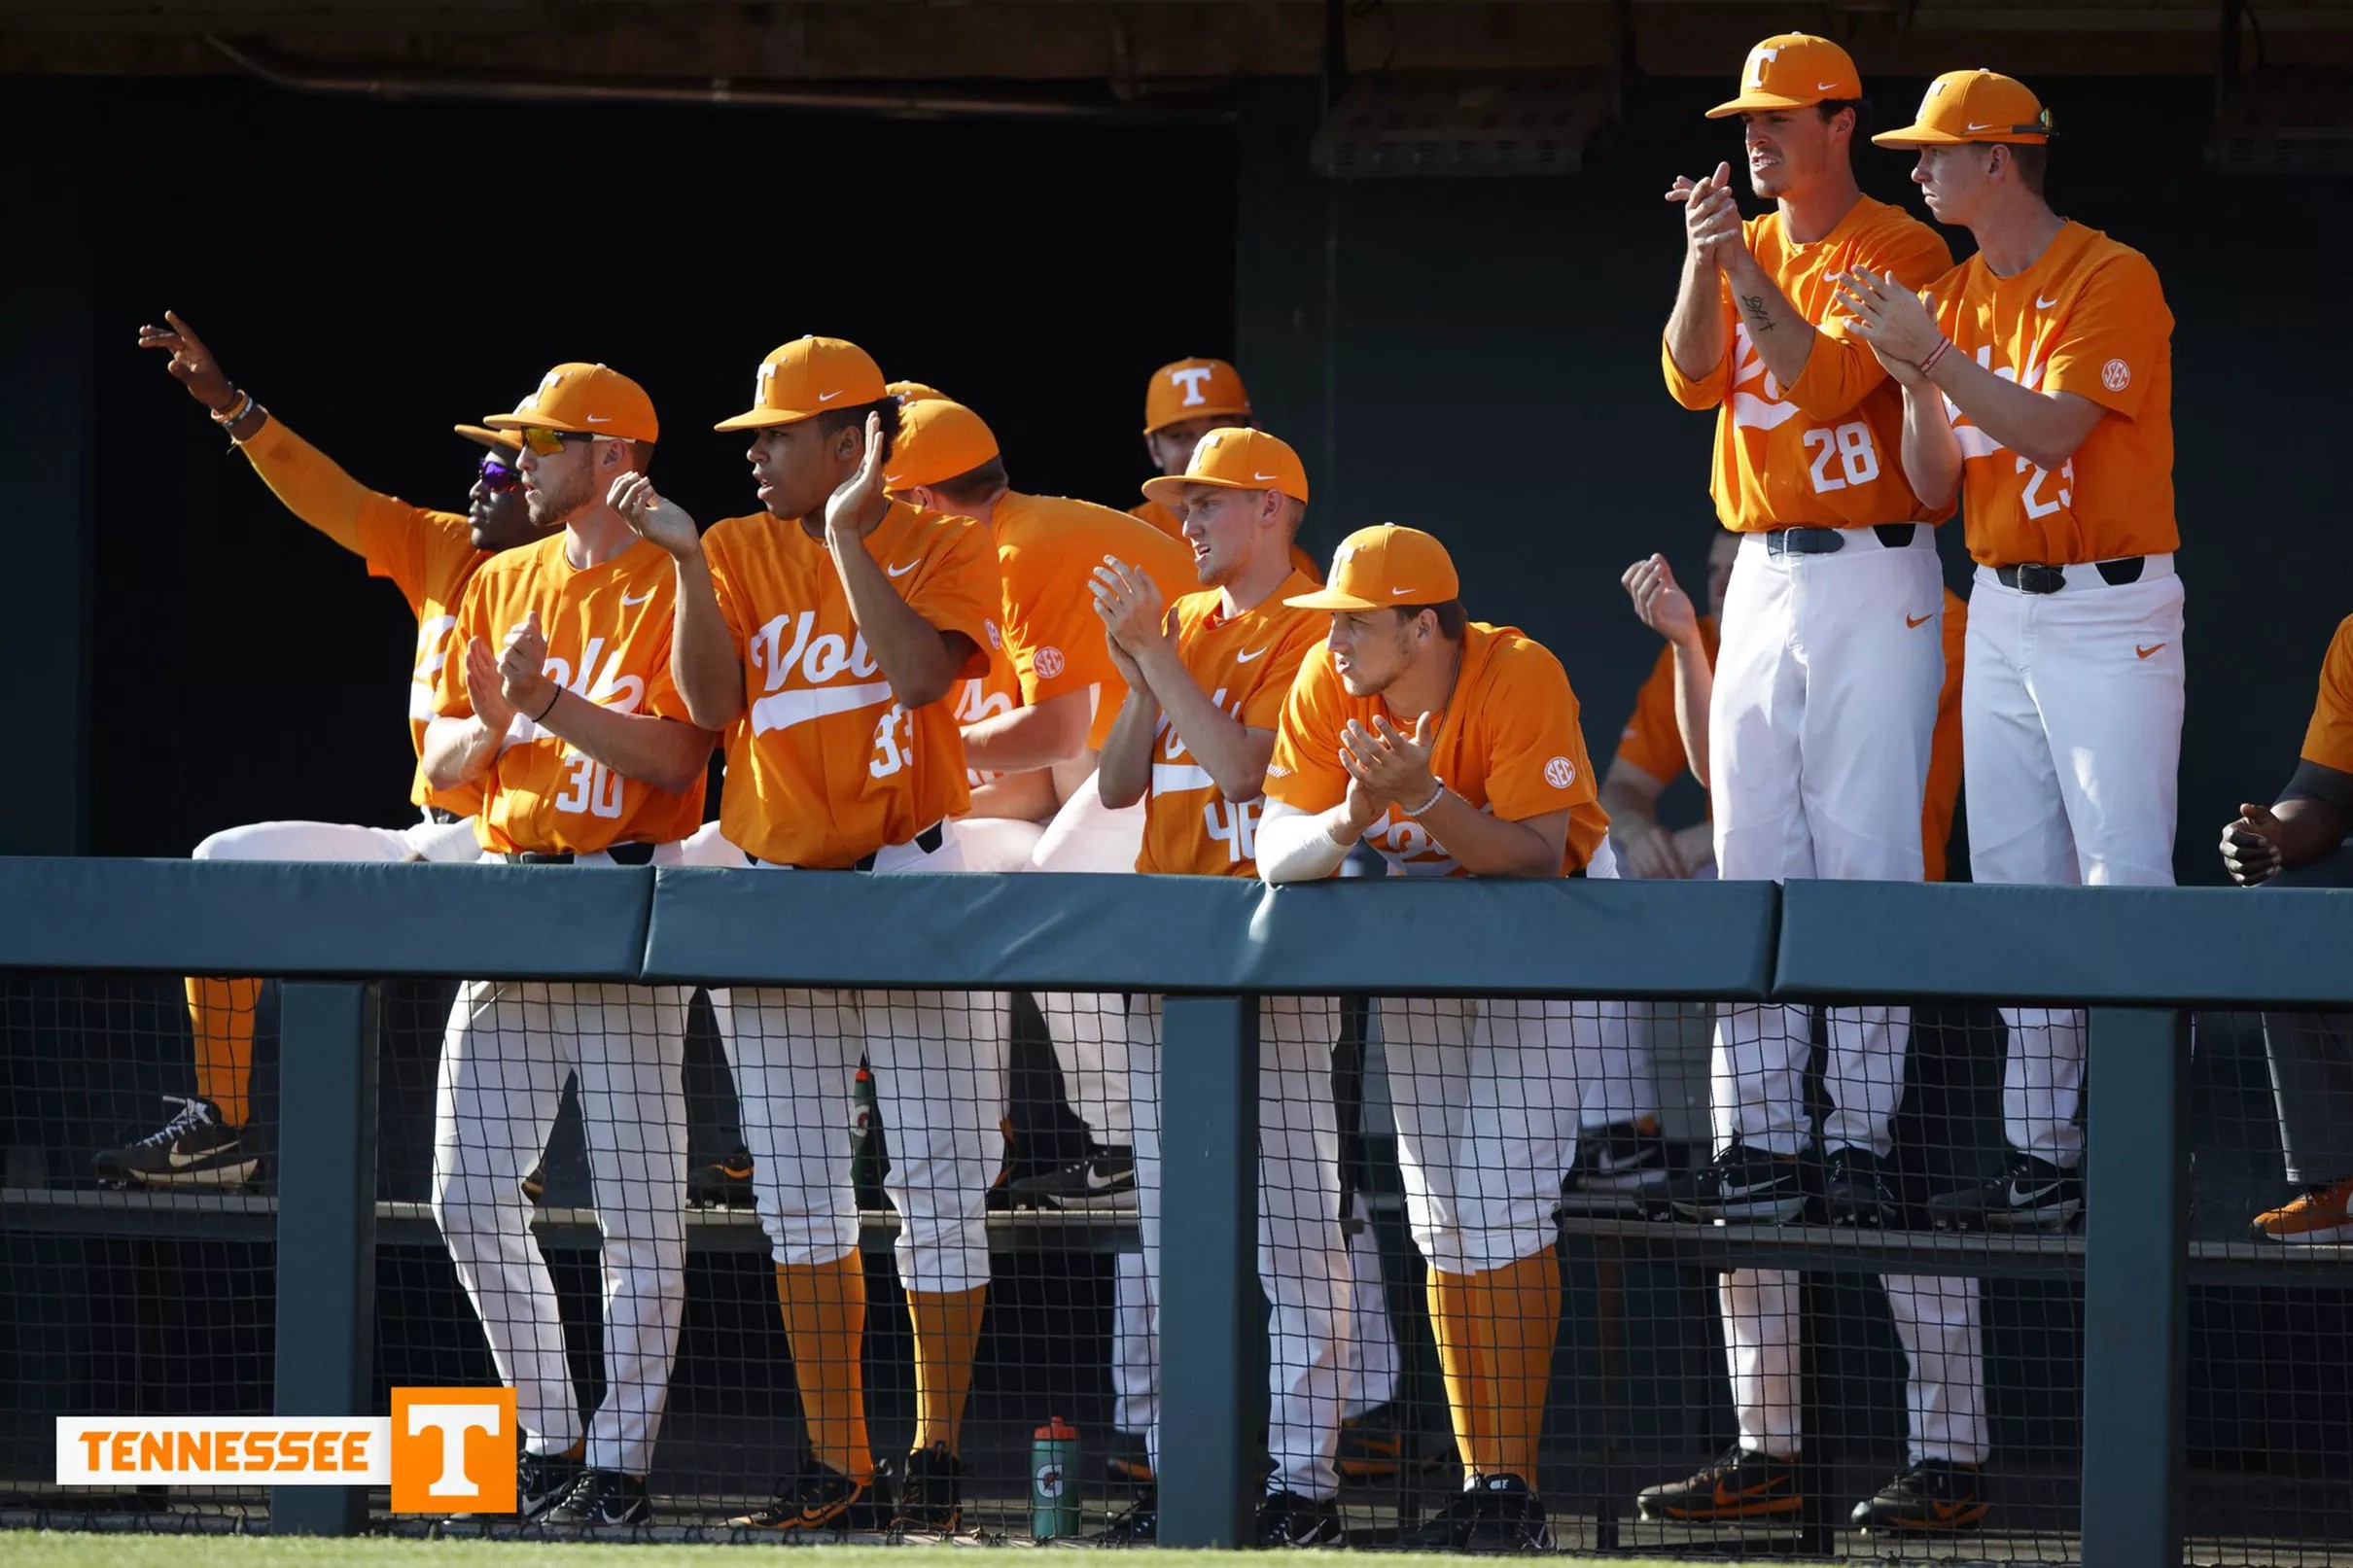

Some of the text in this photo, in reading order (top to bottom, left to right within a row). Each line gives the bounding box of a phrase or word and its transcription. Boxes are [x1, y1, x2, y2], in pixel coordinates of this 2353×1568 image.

[1172, 366, 1212, 407] T
[2104, 362, 2128, 389] SEC
[1803, 420, 1880, 494] 28
[750, 610, 879, 692] Vol
[1034, 649, 1063, 678] SEC
[555, 749, 625, 819] 30
[1547, 758, 1574, 787] SEC
[1036, 1464, 1064, 1498] G
